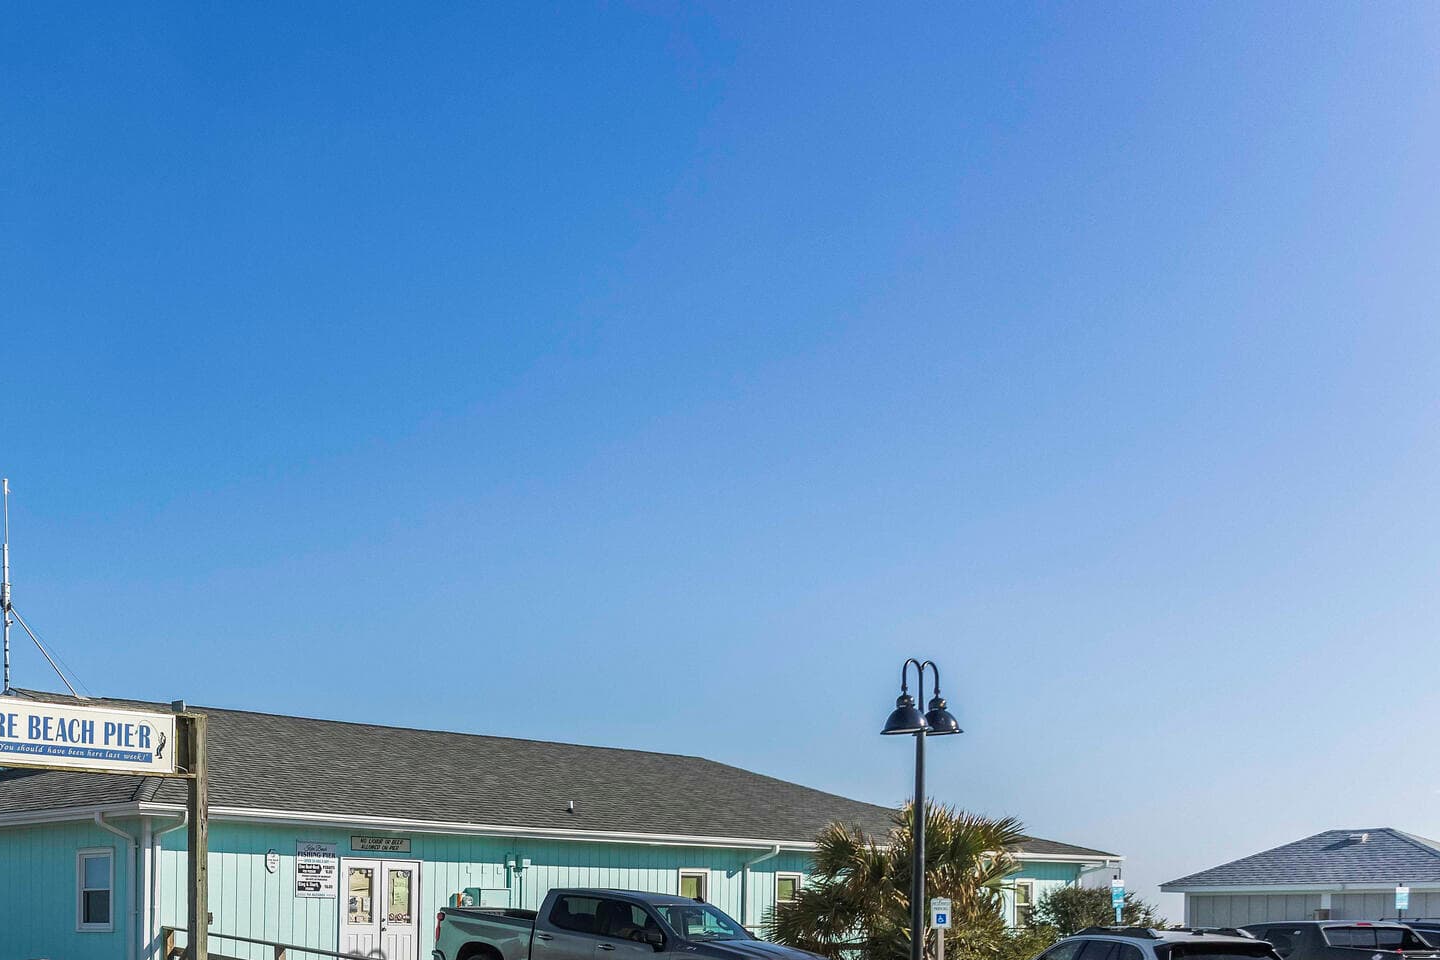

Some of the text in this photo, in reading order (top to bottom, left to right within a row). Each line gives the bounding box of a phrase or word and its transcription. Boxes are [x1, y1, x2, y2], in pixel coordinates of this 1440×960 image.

[28, 715, 94, 744] BEACH
[104, 721, 150, 748] PIER
[16, 745, 43, 753] should
[47, 744, 65, 755] have
[67, 746, 84, 756] been
[87, 749, 103, 757] here
[106, 751, 120, 759] last
